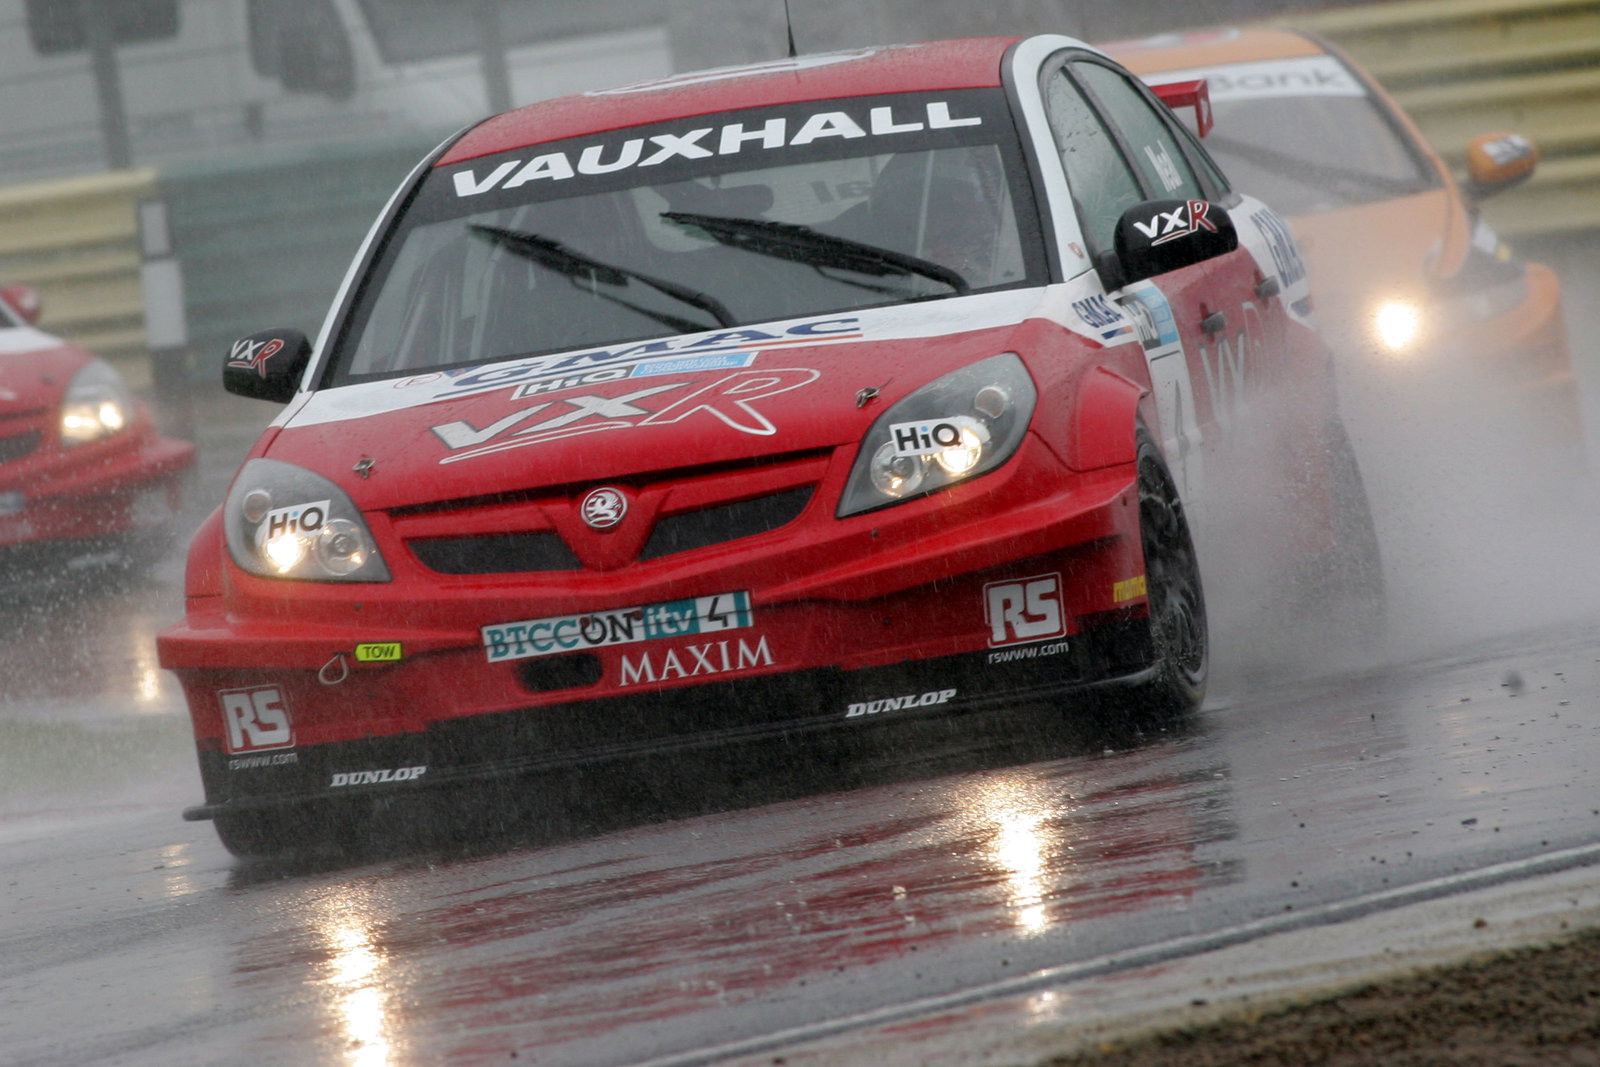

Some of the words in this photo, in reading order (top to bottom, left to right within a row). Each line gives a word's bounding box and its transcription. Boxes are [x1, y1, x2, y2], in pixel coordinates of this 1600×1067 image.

[453, 102, 982, 197] VAUXHALL
[1133, 200, 1218, 246] VXR
[228, 339, 285, 378] VXR
[453, 317, 860, 387] GMAC
[523, 369, 629, 397] HiQ
[428, 368, 822, 458] VXR
[895, 423, 962, 451] HiQ
[268, 507, 324, 539] HiQ
[988, 578, 1062, 642] RS
[363, 646, 396, 659] TOW
[619, 635, 775, 687] MAXIM
[988, 641, 1070, 664] rswww.com
[222, 689, 290, 749] RS
[845, 689, 957, 718] DUNLOP
[228, 752, 298, 770] rswww.com
[330, 766, 427, 787] DUNLOP
